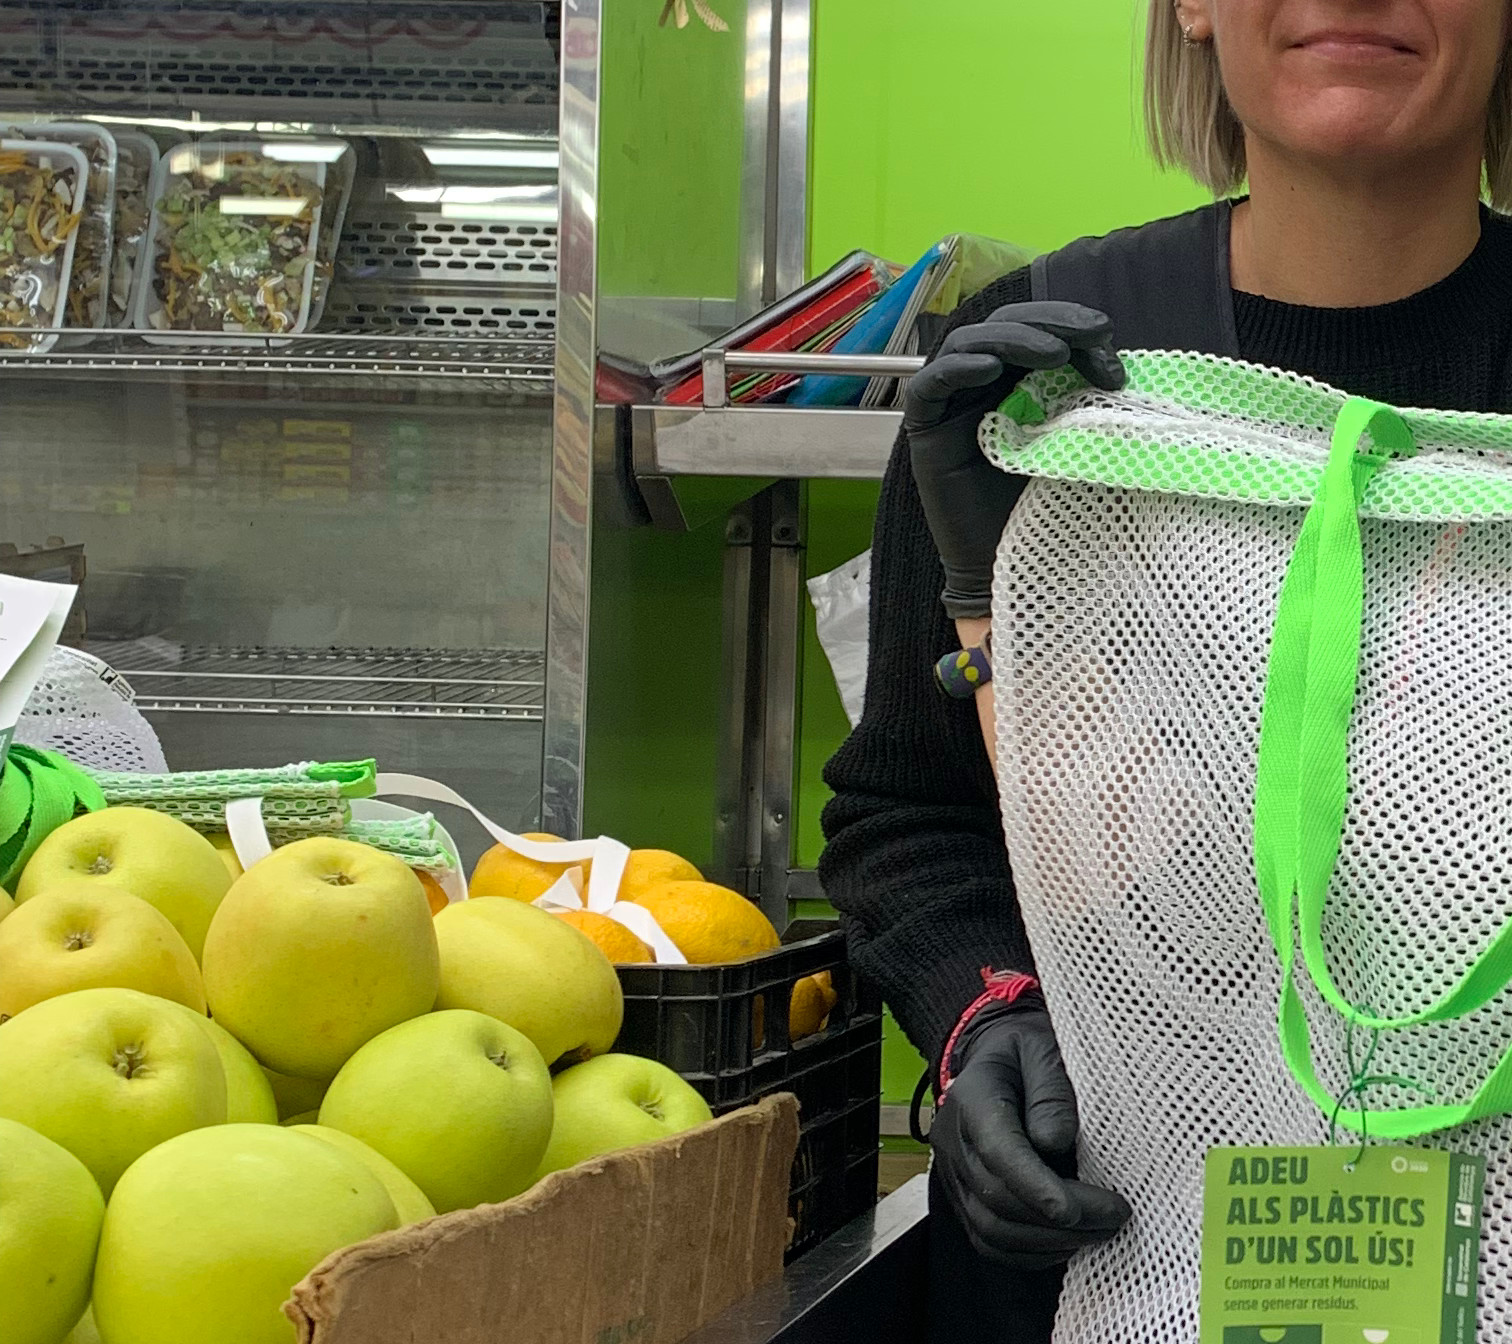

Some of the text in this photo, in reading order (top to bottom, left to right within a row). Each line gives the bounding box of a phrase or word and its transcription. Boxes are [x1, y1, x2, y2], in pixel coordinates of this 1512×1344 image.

[1227, 1155, 1309, 1186] ADEU
[1226, 1190, 1426, 1228] ALS PLÀSTICS
[1305, 1235, 1360, 1265] SOL
[1367, 1230, 1415, 1268] ÚS!
[1224, 1275, 1390, 1293] Compra al Mercat Municipal
[1223, 1295, 1359, 1315] sense generar residus.
